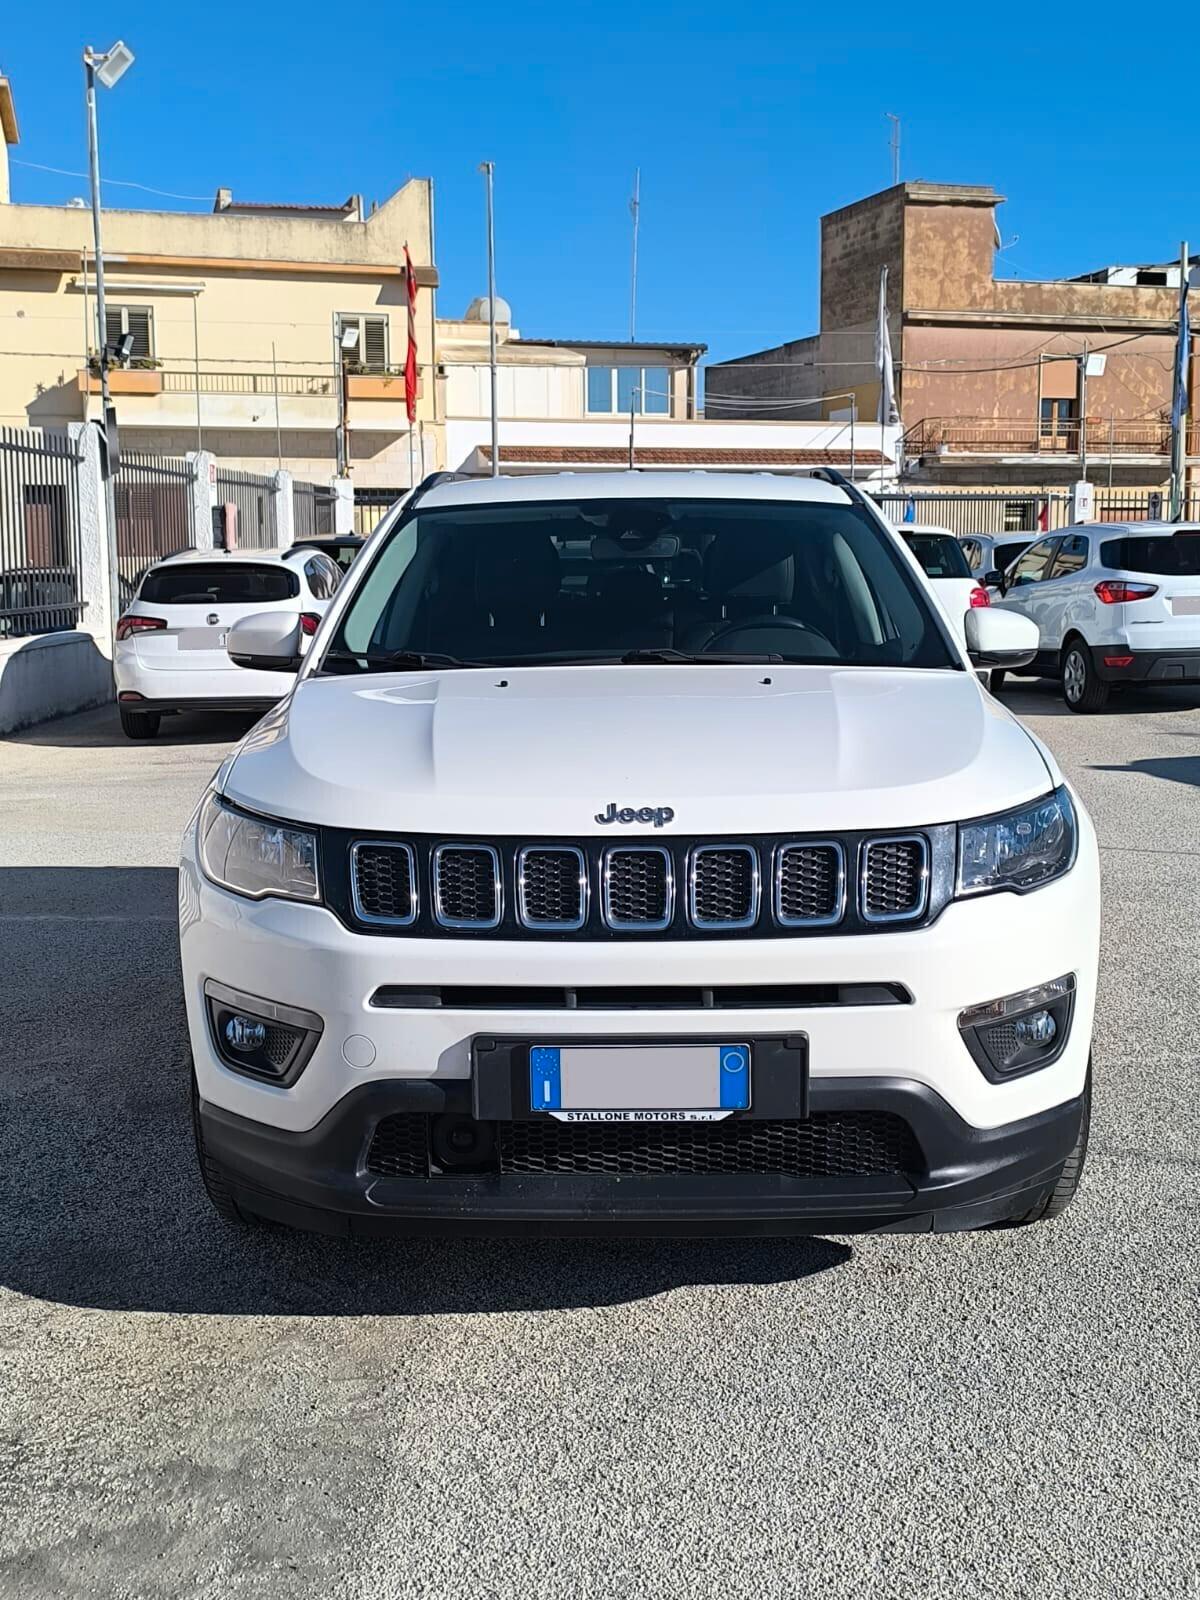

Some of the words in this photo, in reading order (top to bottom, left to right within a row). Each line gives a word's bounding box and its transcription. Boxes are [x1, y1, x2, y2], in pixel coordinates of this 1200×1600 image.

[594, 803, 675, 828] Jeep
[543, 1080, 550, 1102] I
[567, 1112, 631, 1121] STALLONE
[634, 1112, 686, 1121] MOTORS
